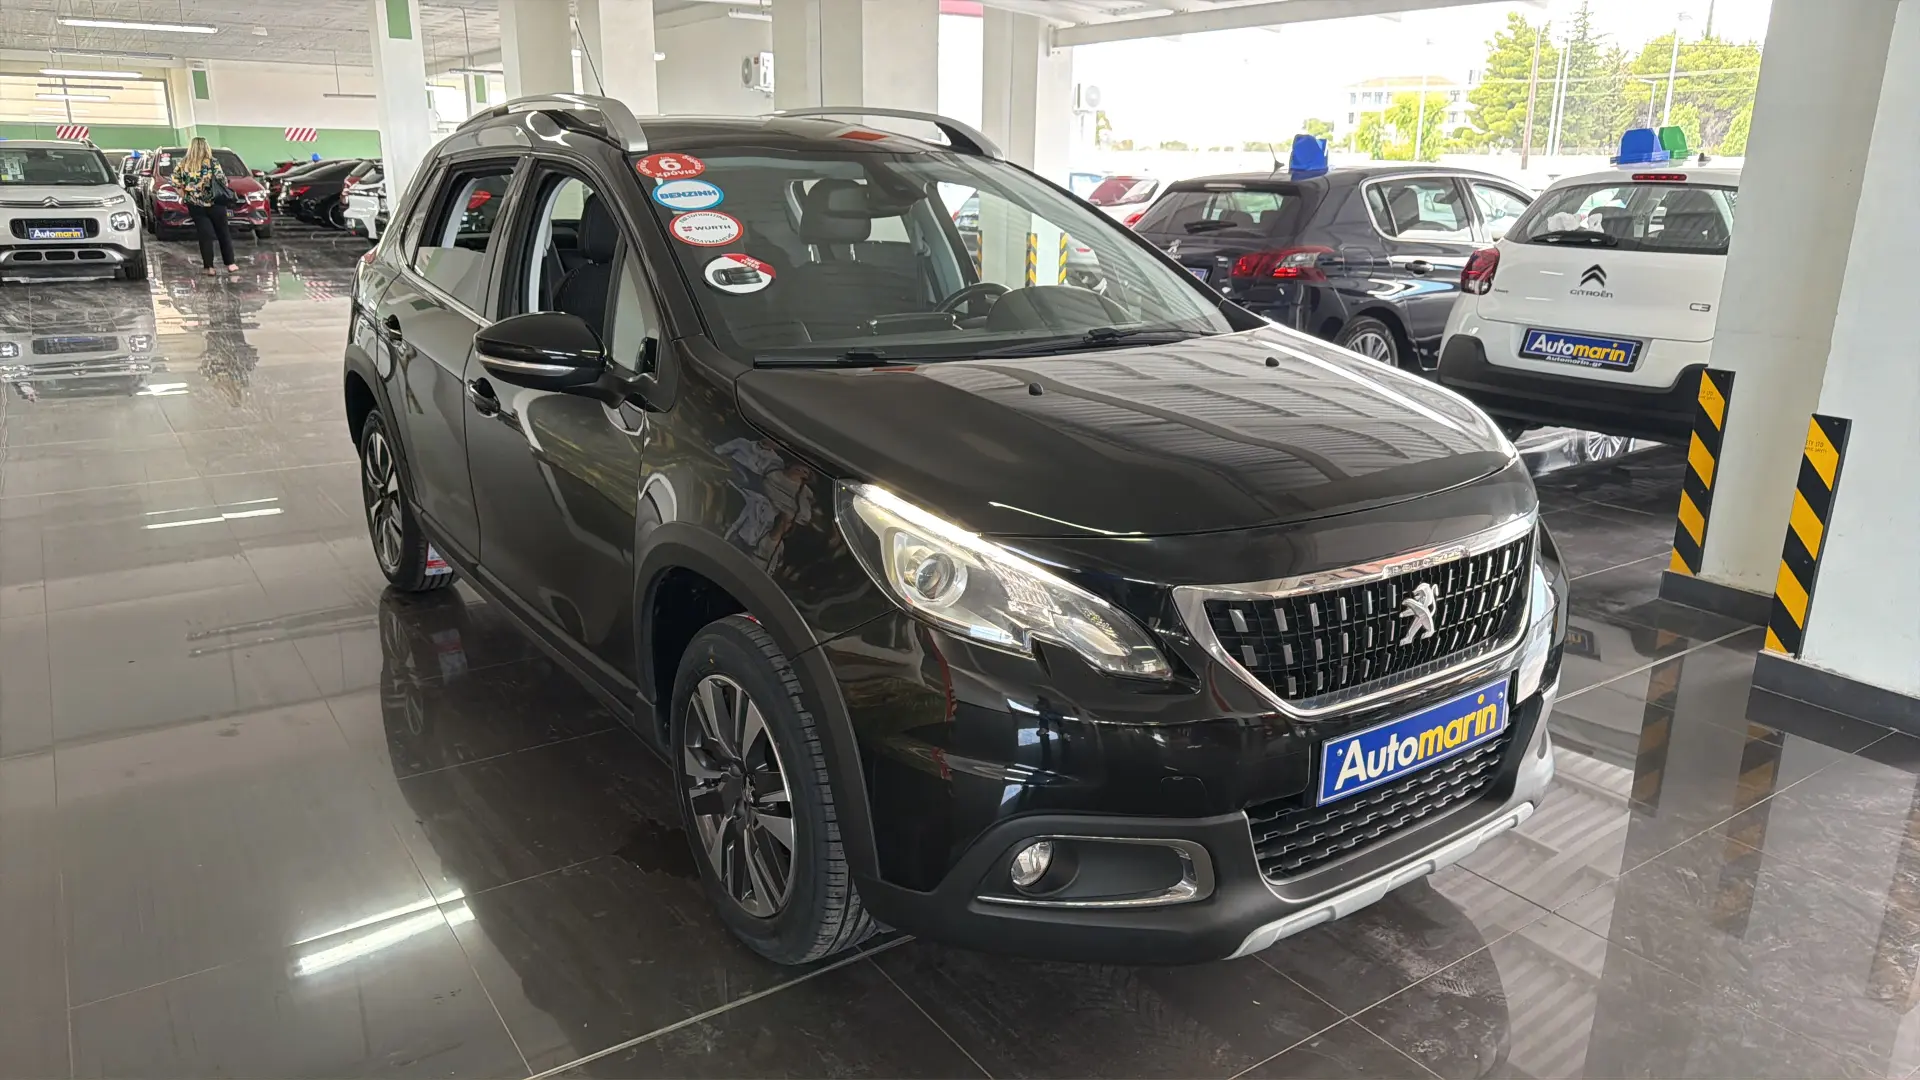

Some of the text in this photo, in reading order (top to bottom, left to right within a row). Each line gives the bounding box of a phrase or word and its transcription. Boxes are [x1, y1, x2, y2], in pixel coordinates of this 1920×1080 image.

[659, 158, 681, 171] 6
[655, 168, 697, 178] χρόνια
[33, 229, 81, 239] Automarin
[1689, 302, 1711, 312] C3
[1530, 333, 1626, 363] Automarin
[1545, 354, 1603, 368] Automarin.gr
[1333, 693, 1497, 791] Automarin
